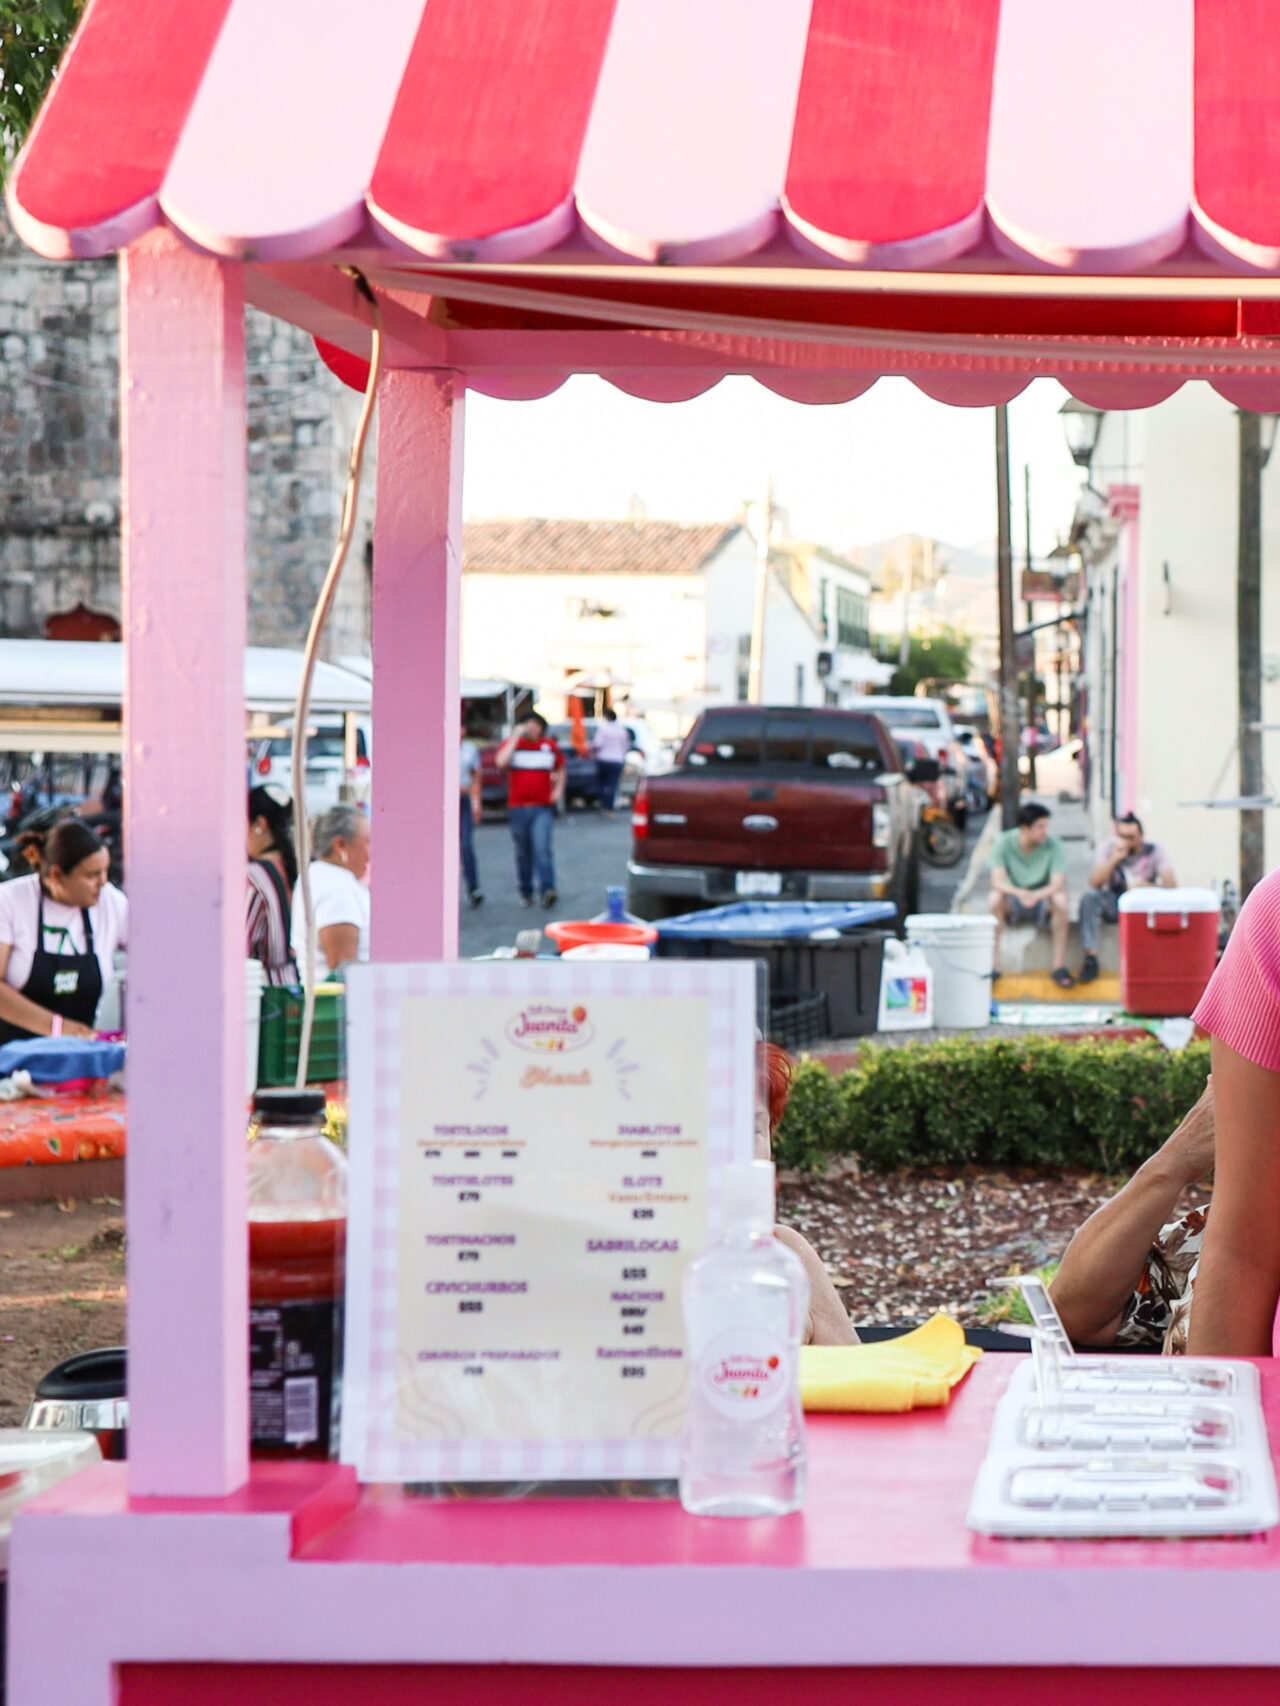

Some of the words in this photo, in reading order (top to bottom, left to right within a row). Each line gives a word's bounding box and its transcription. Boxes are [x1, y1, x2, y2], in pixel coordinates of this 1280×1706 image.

[514, 1012, 578, 1037] Juanita
[587, 1239, 679, 1252] SABRILOCAS
[714, 1360, 769, 1384] Juanita
